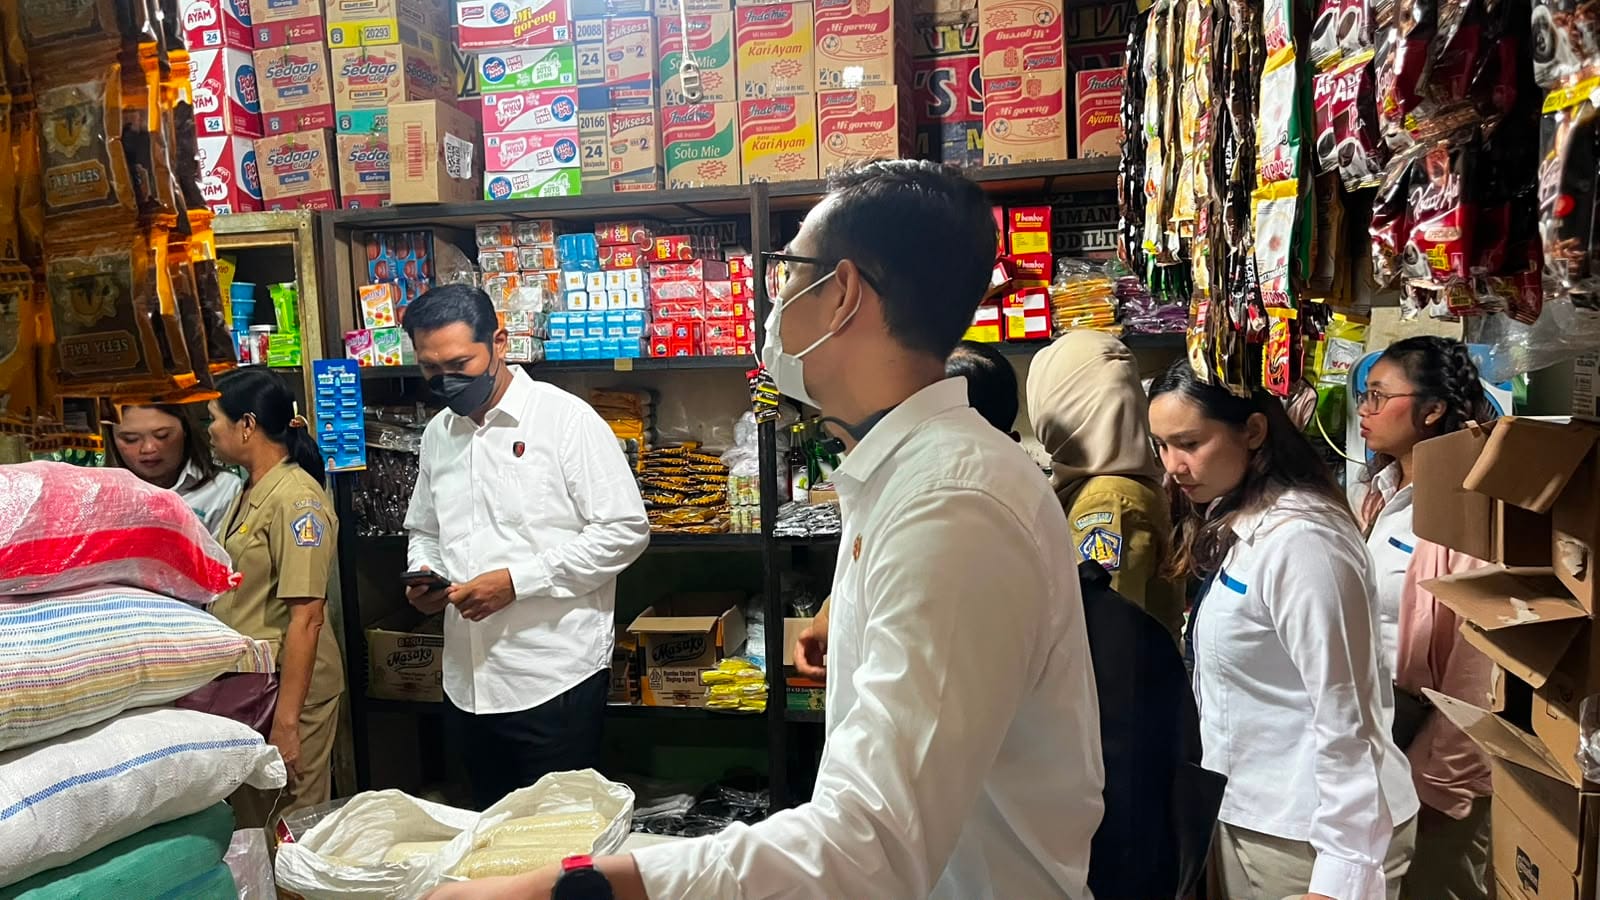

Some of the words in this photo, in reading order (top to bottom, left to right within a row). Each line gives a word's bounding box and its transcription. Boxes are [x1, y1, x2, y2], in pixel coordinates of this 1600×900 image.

[187, 10, 212, 24] AYAM
[513, 10, 556, 38] goreng
[831, 23, 843, 32] Mi
[843, 23, 878, 34] goreng
[206, 33, 218, 42] 24
[260, 32, 268, 42] 8
[290, 28, 301, 38] 12
[301, 28, 316, 36] Cups
[366, 27, 389, 39] 20293
[557, 29, 566, 37] 12
[577, 24, 602, 38] 20088
[333, 34, 341, 42] 8
[636, 45, 645, 58] 2
[748, 45, 770, 57] Kari
[771, 44, 802, 57] Ayam
[581, 53, 599, 66] 24
[265, 63, 318, 79] Sedaap
[341, 62, 397, 77] Sedaap
[193, 96, 214, 109] YAM
[1012, 105, 1049, 117] goreng
[208, 119, 220, 129] 24
[271, 120, 279, 130] 8
[300, 117, 311, 126] 12
[341, 119, 349, 128] 8
[580, 115, 605, 129] 20166
[848, 121, 882, 132] goreng
[1087, 114, 1113, 127] Ayam
[640, 138, 649, 150] 2
[752, 139, 774, 151] Kari
[775, 138, 806, 151] Ayam
[584, 144, 603, 159] 24
[700, 144, 720, 158] Mie
[266, 150, 319, 167] Sedaap
[203, 184, 222, 196] YAM
[652, 637, 705, 662] Masako
[386, 647, 433, 667] Masako
